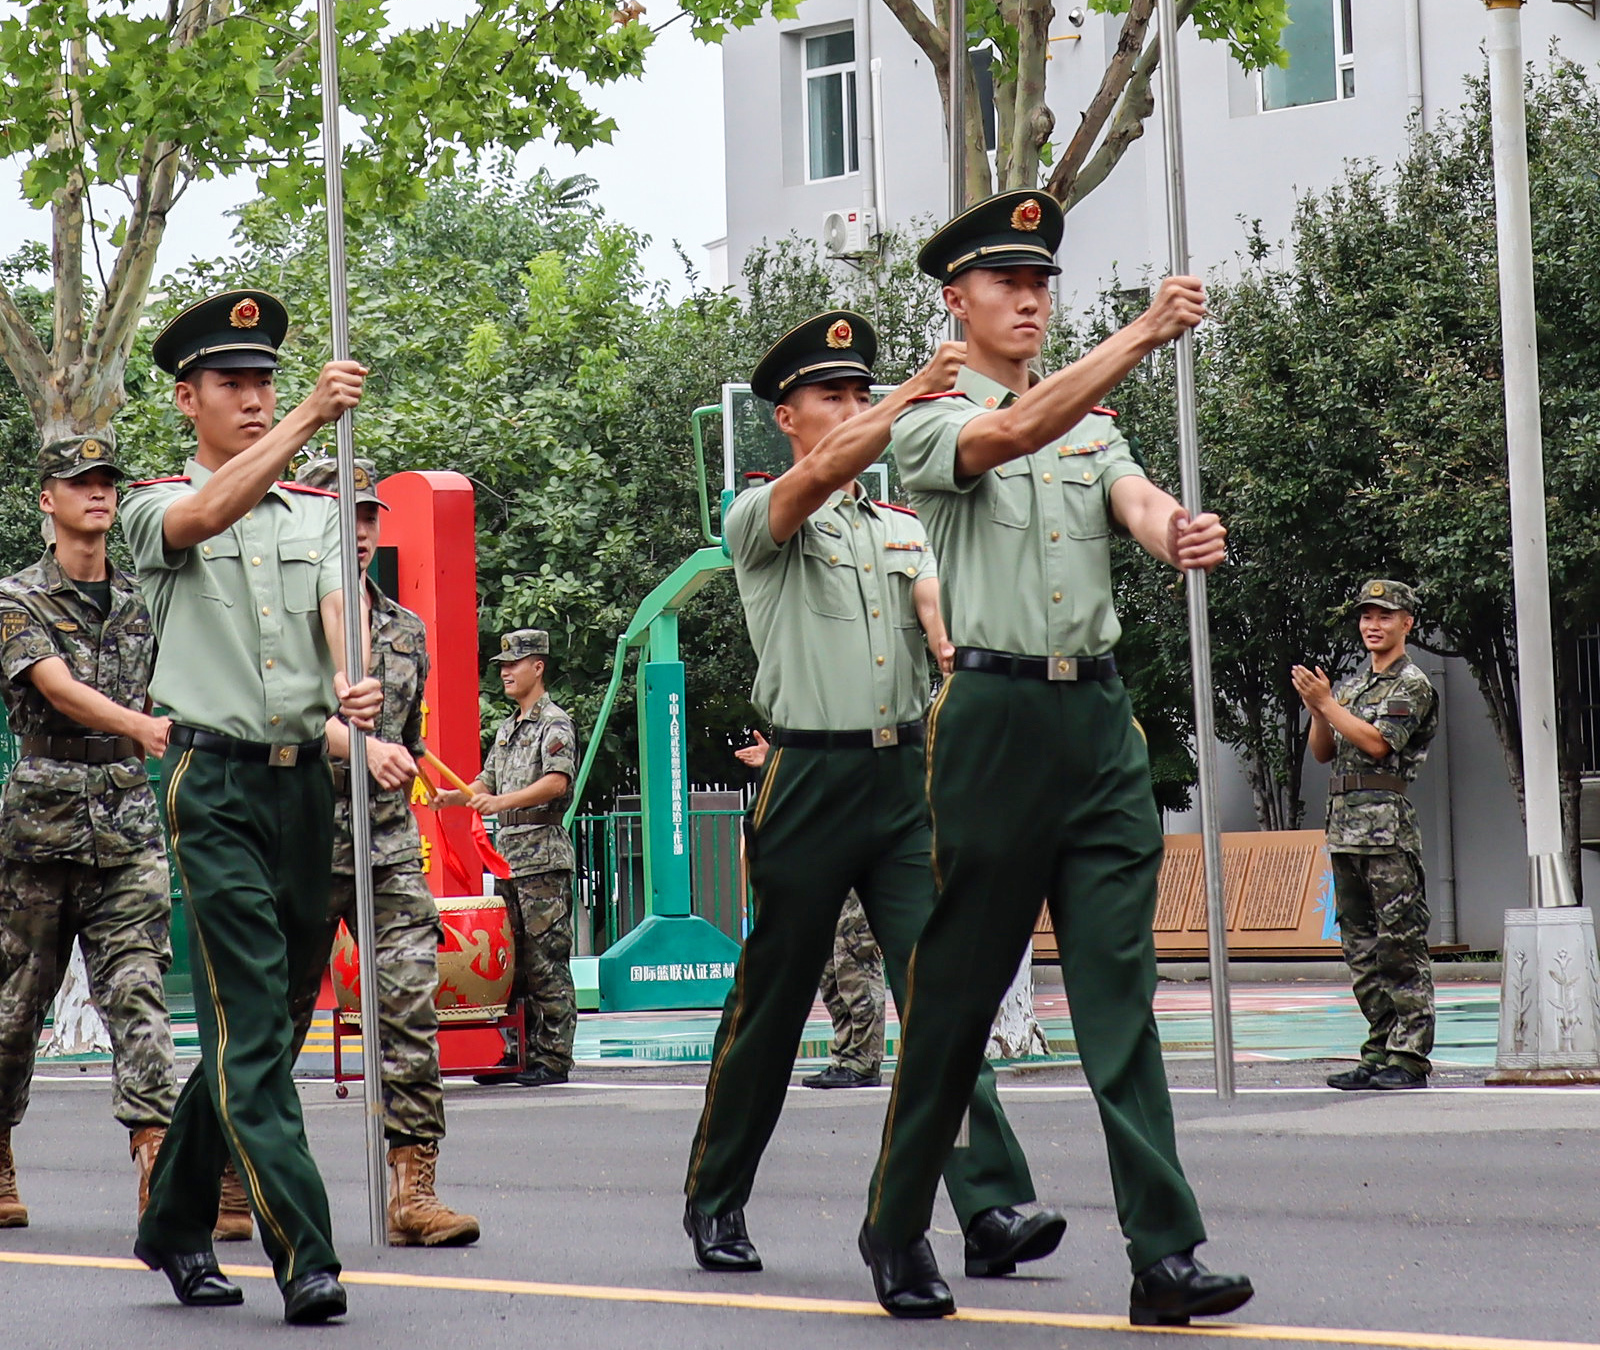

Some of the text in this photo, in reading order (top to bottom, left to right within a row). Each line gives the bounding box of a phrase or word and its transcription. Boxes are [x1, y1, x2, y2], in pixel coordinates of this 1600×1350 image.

[630, 962, 736, 981] 国际篮联认证器材
